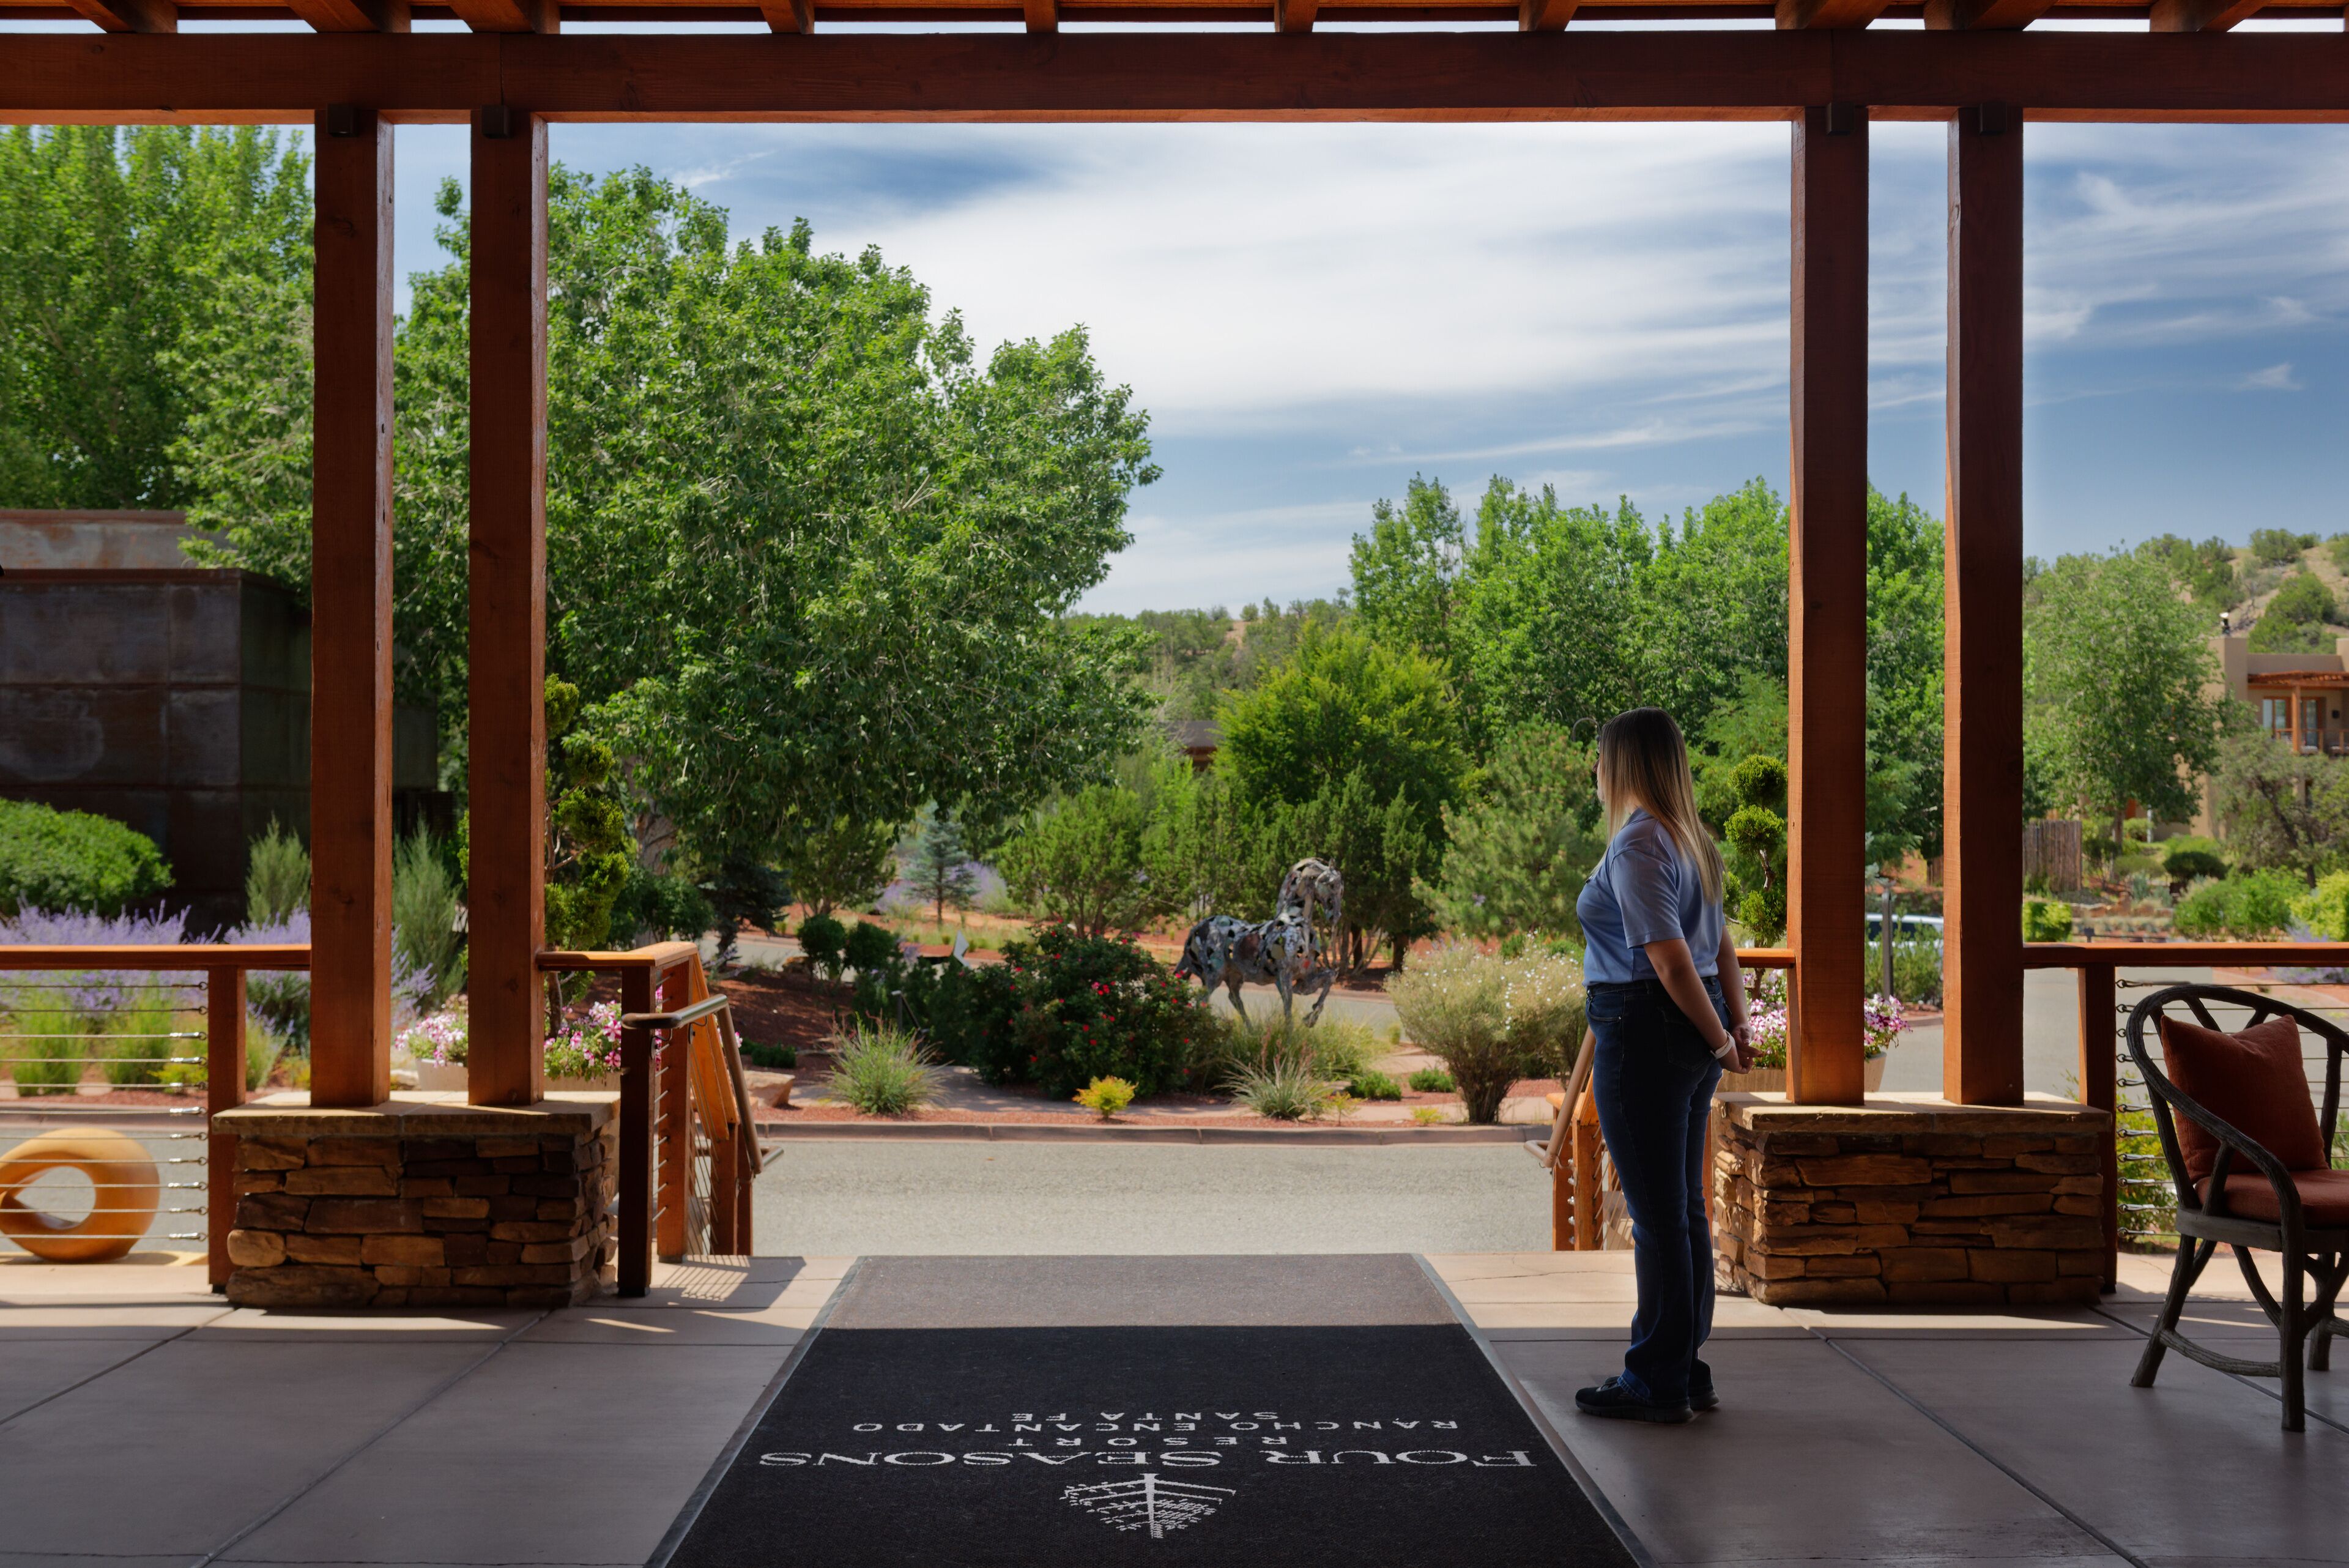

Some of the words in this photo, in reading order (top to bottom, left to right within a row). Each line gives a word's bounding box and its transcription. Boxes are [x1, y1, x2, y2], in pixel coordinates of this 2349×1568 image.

[1011, 1413, 1067, 1422] FE
[1099, 1412, 1279, 1421] SANTA
[853, 1422, 1196, 1432] ENCANTADO
[1230, 1421, 1458, 1430] RANCHO
[1008, 1436, 1288, 1446] RESORT
[760, 1451, 1223, 1466] SEASONS
[1259, 1450, 1537, 1467] FOUR
